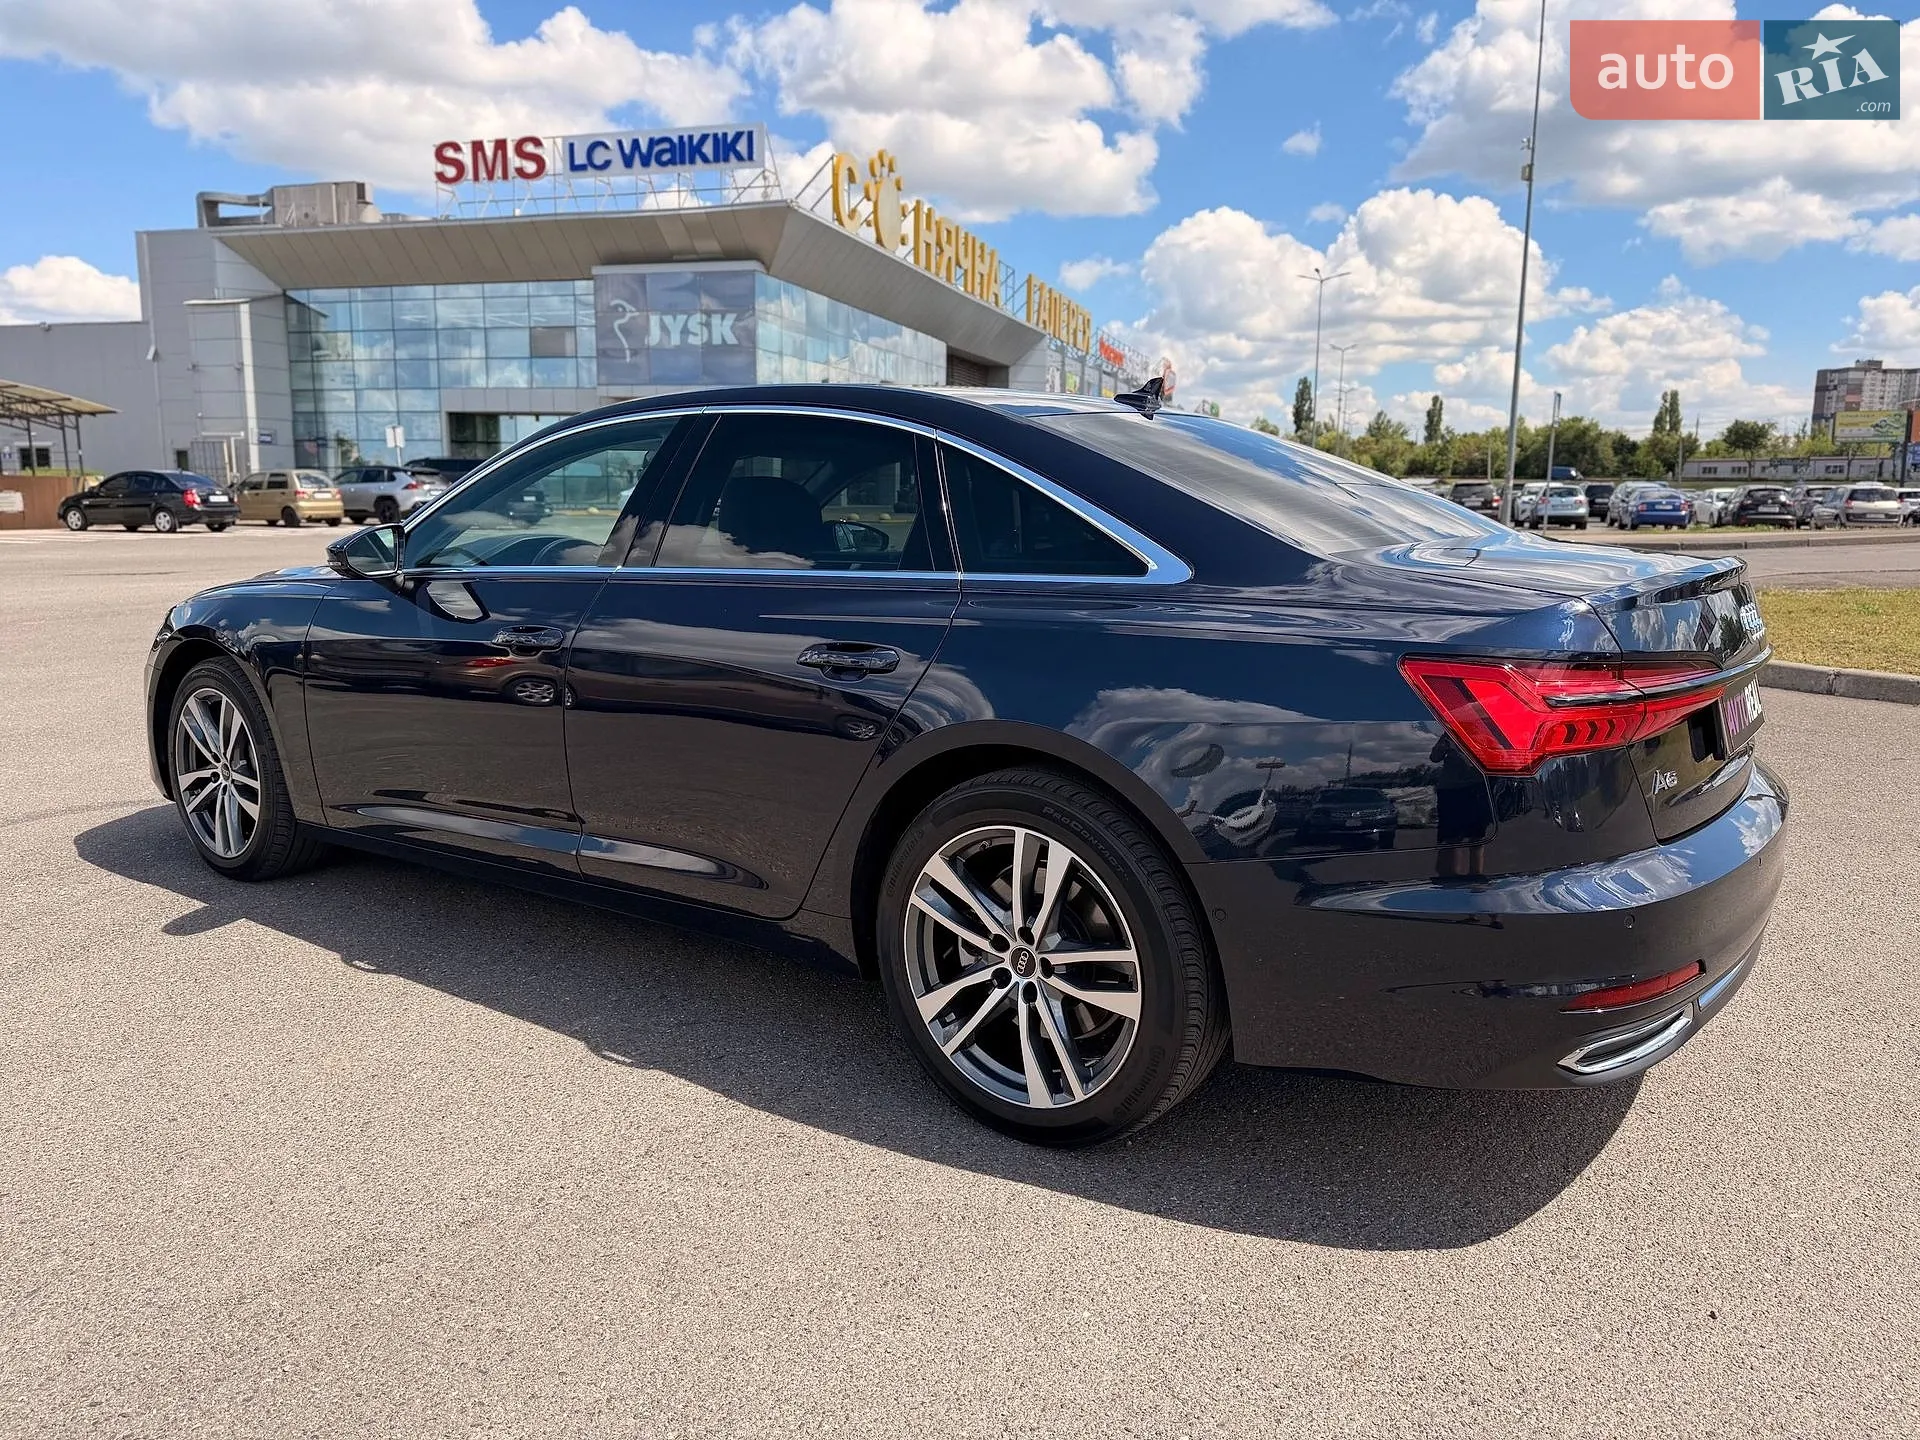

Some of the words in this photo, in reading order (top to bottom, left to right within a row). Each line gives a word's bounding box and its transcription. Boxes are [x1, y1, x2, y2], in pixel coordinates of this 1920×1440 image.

[434, 136, 546, 184] SMS
[569, 140, 611, 172] LC
[645, 312, 739, 346] JYSK
[1652, 769, 1678, 795] A6
